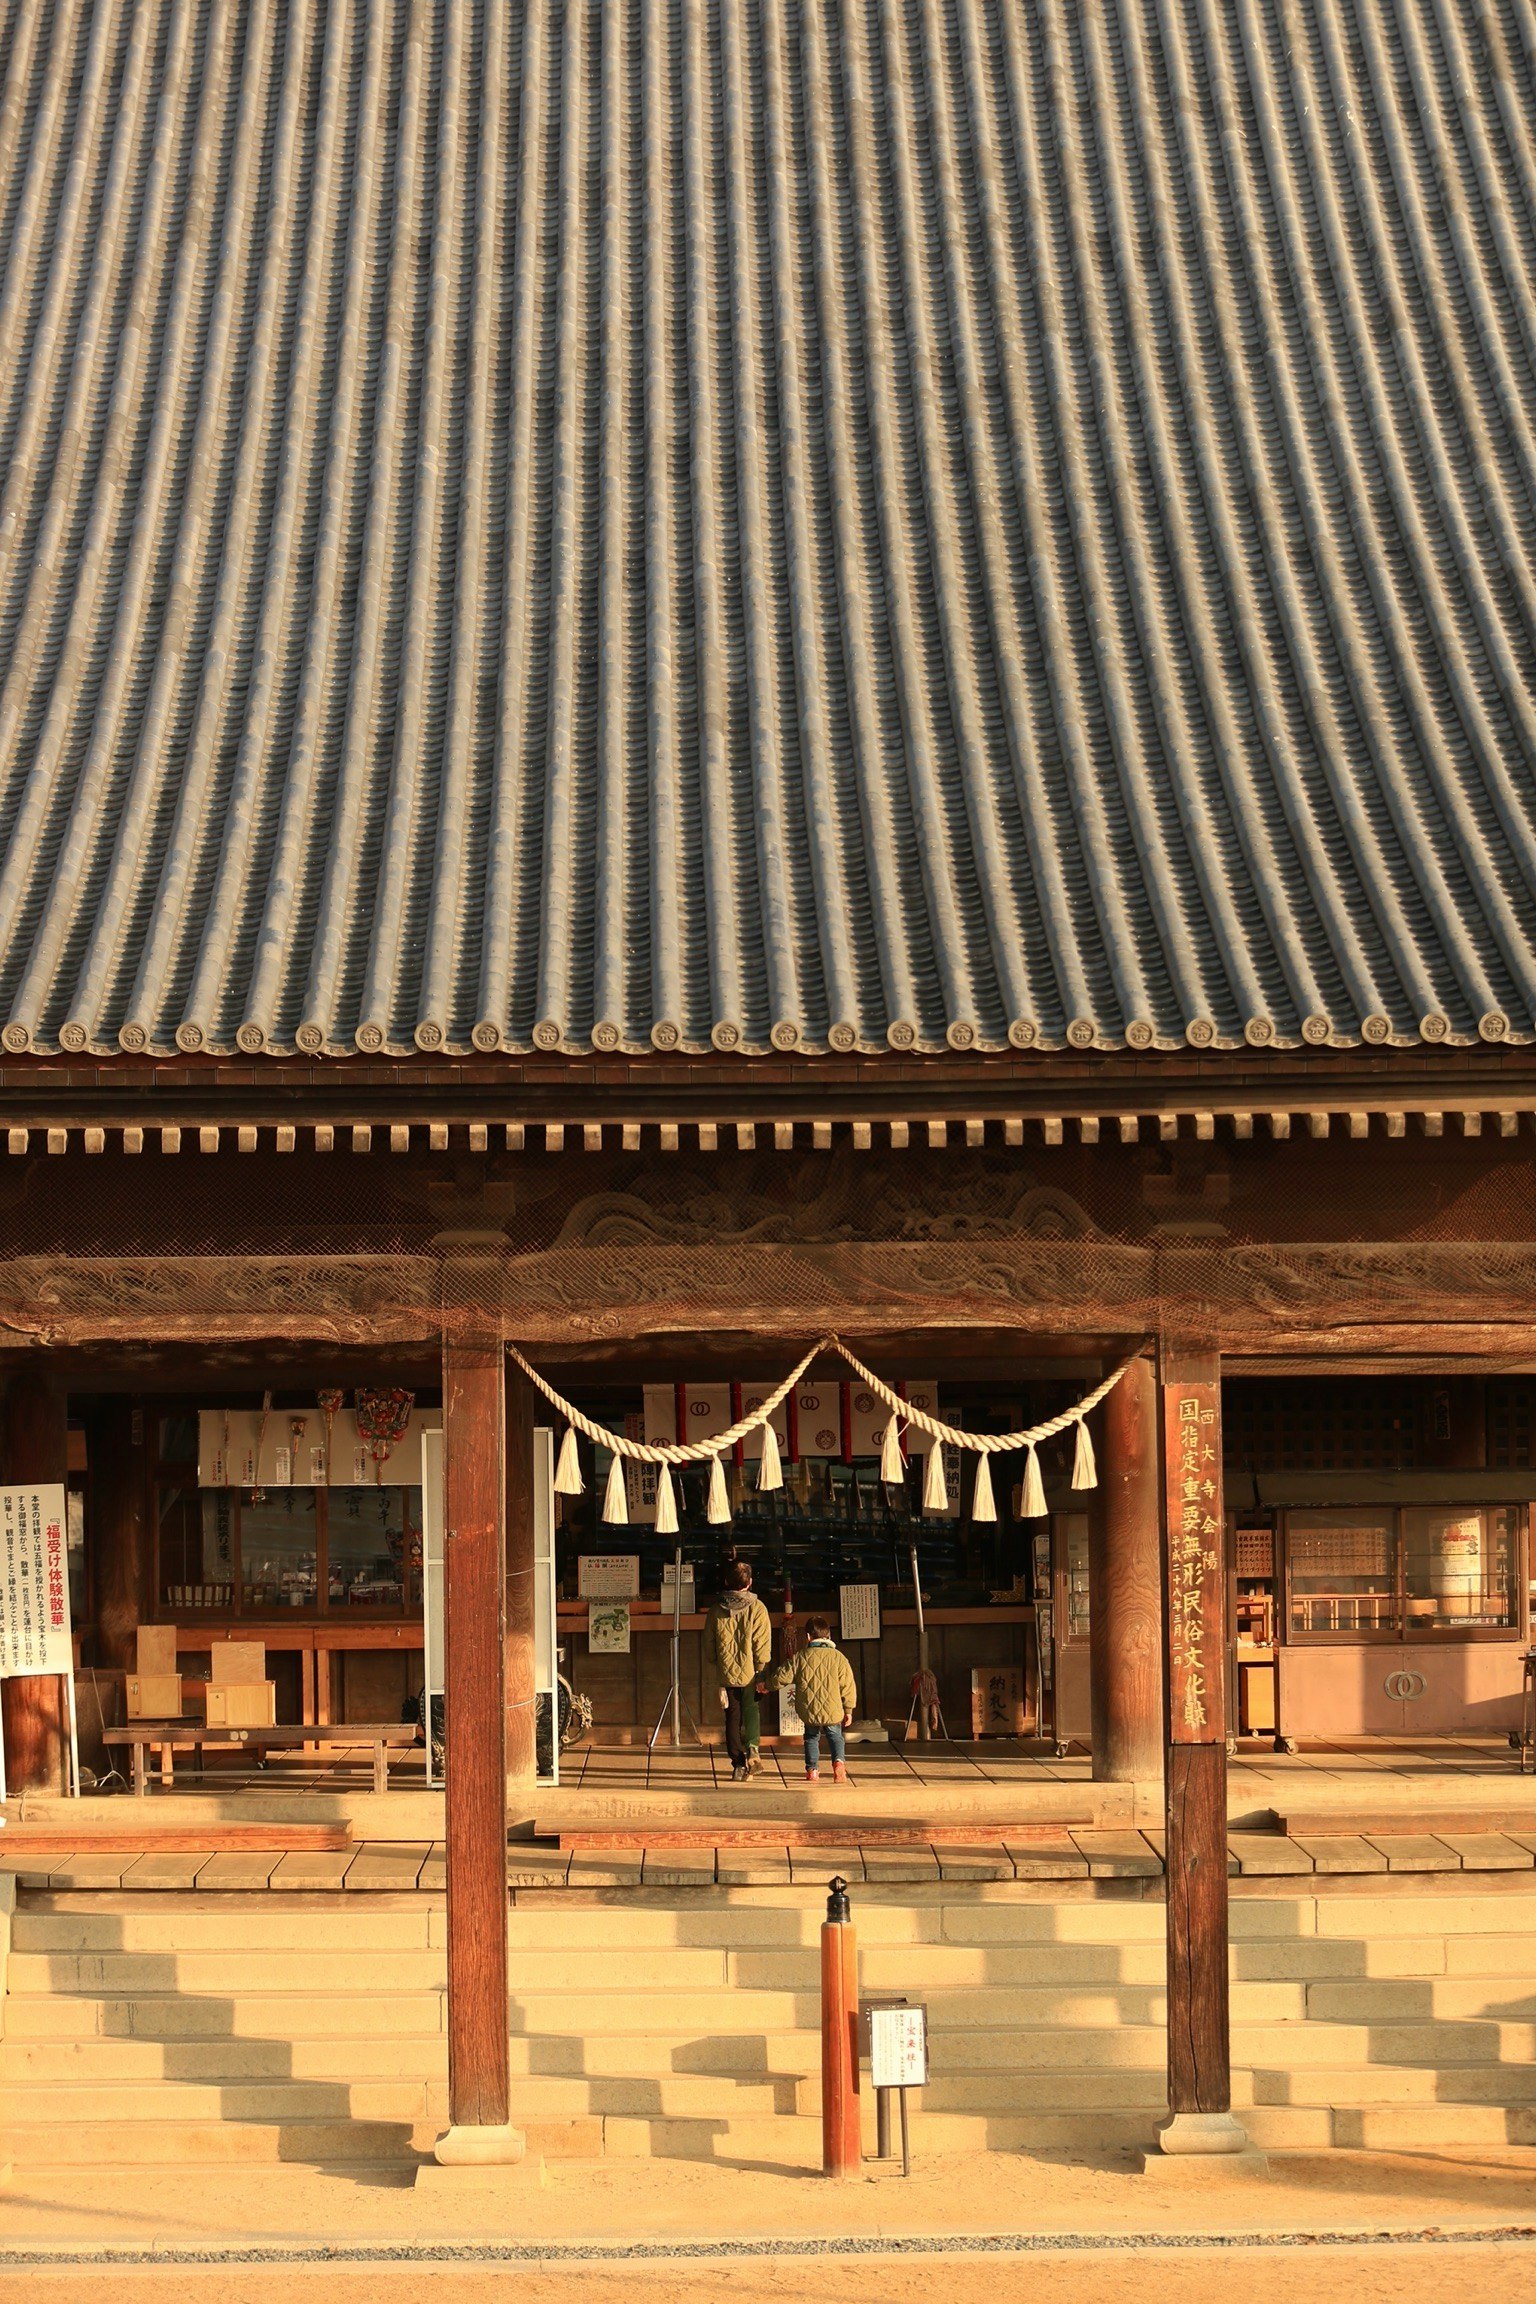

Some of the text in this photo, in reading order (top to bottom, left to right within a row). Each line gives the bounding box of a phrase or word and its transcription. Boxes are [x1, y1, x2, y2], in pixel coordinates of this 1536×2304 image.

[946, 1412, 960, 1499] 御経奉納処
[1199, 1408, 1219, 1571] 西大寺会陽
[1171, 1535, 1183, 1666] 平成二十八年三月二日
[1179, 1398, 1207, 1729] 国指定重要無形民俗文化財
